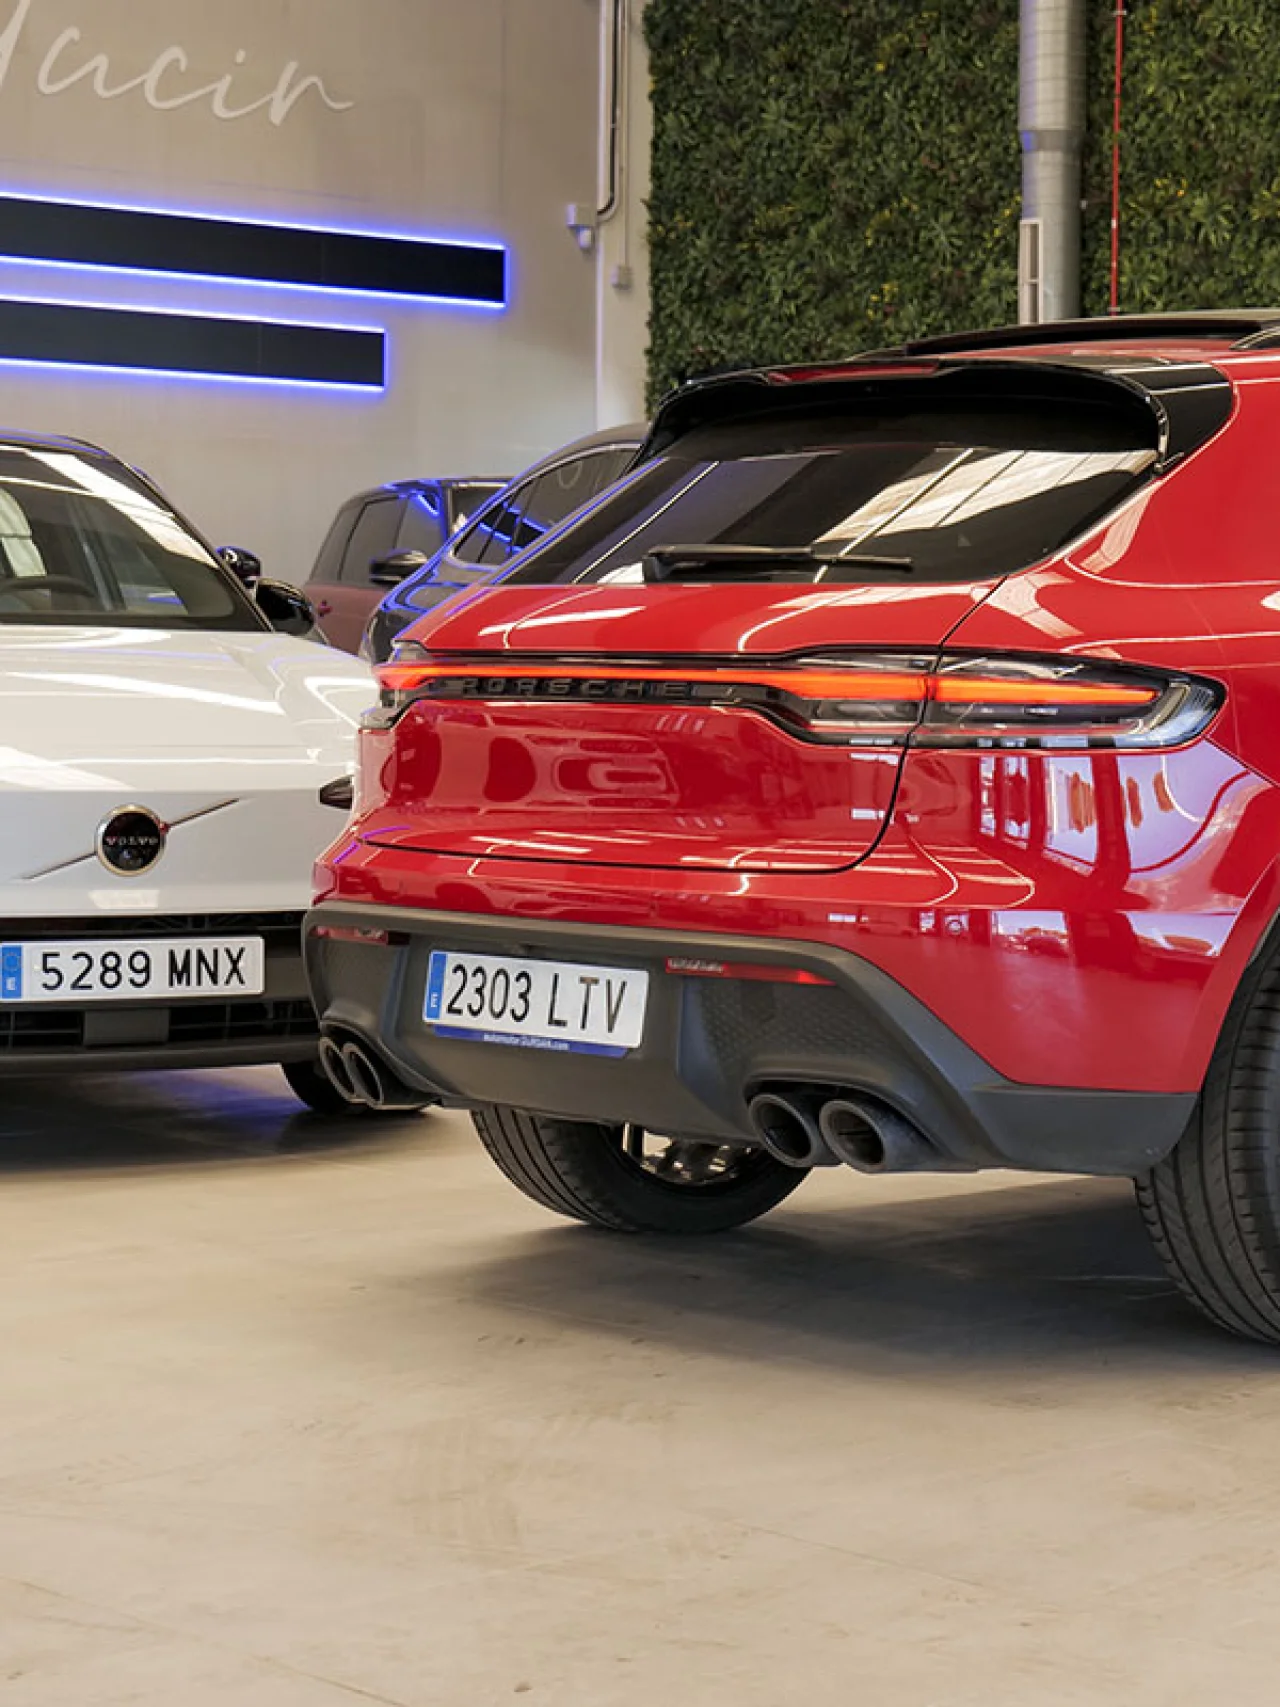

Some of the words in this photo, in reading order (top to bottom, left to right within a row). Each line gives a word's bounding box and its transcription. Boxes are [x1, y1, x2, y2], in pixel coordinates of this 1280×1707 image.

[462, 677, 688, 695] PORSCHE
[105, 836, 159, 846] VOLVO
[41, 951, 151, 990] 5289
[168, 947, 246, 987] MNX
[447, 963, 532, 1023] 2303
[547, 973, 627, 1033] LTV
